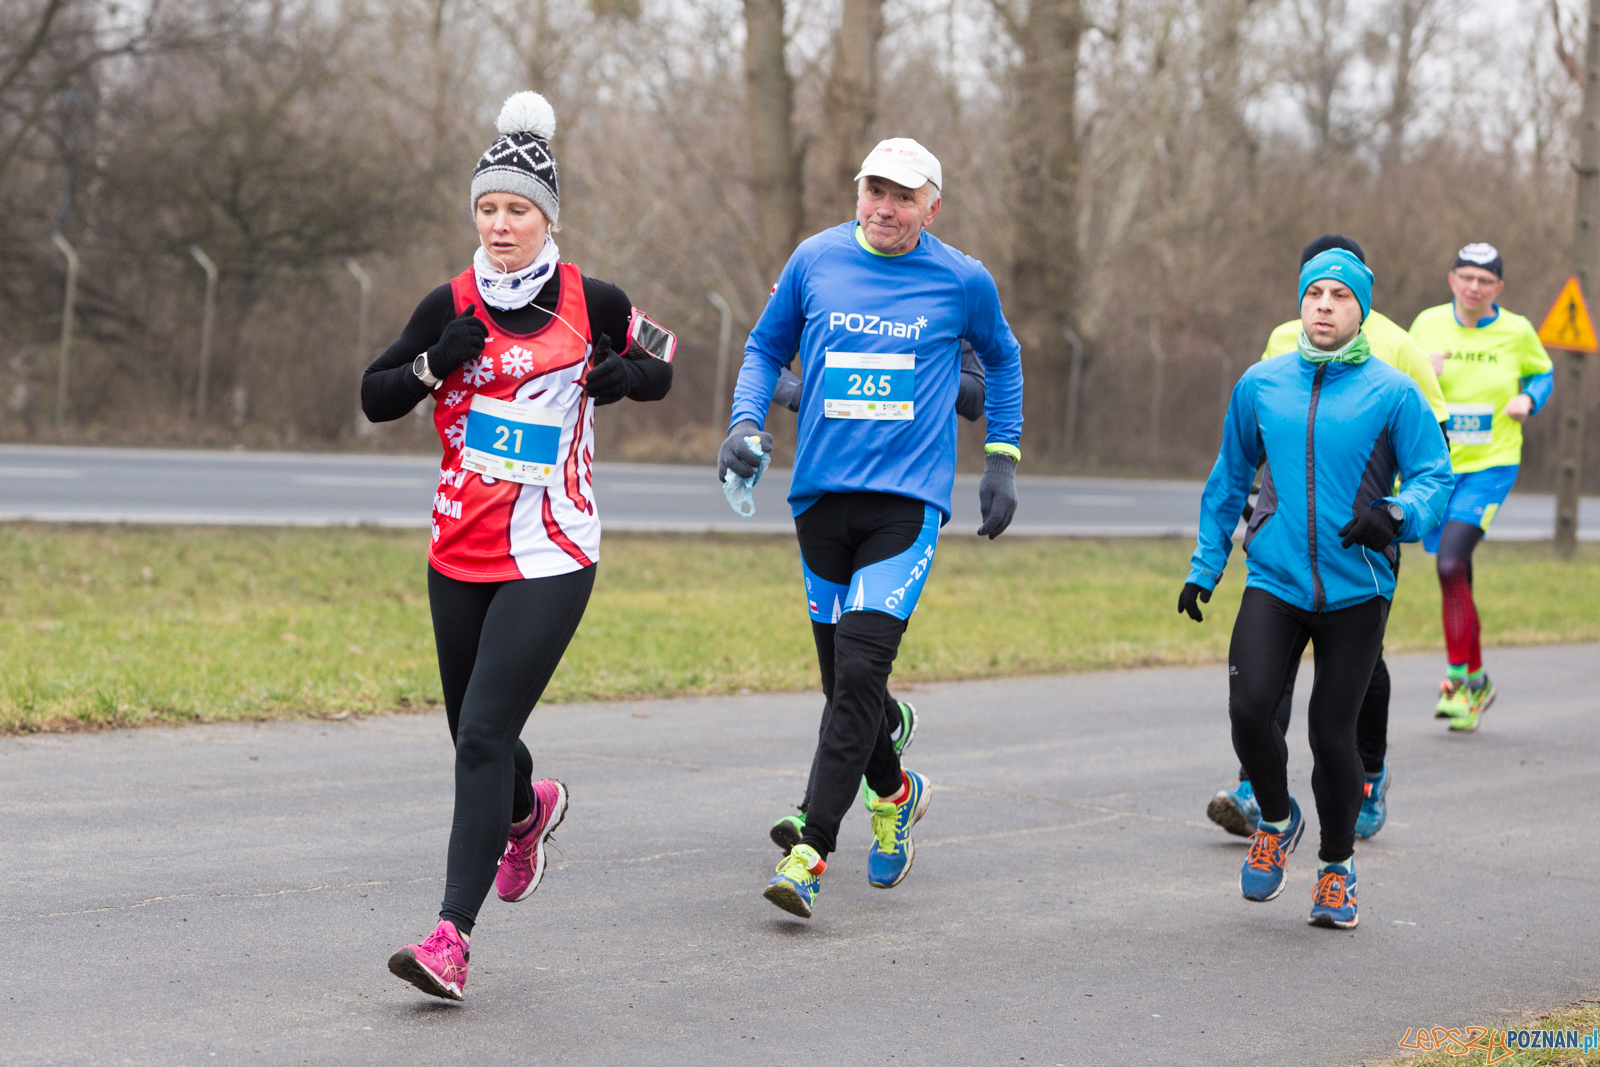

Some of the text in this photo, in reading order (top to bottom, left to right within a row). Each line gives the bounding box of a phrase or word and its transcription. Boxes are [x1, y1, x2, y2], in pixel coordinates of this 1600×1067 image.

[847, 373, 891, 397] 265
[1453, 415, 1481, 431] 230
[492, 425, 523, 454] 21
[885, 544, 934, 609] MANIAC
